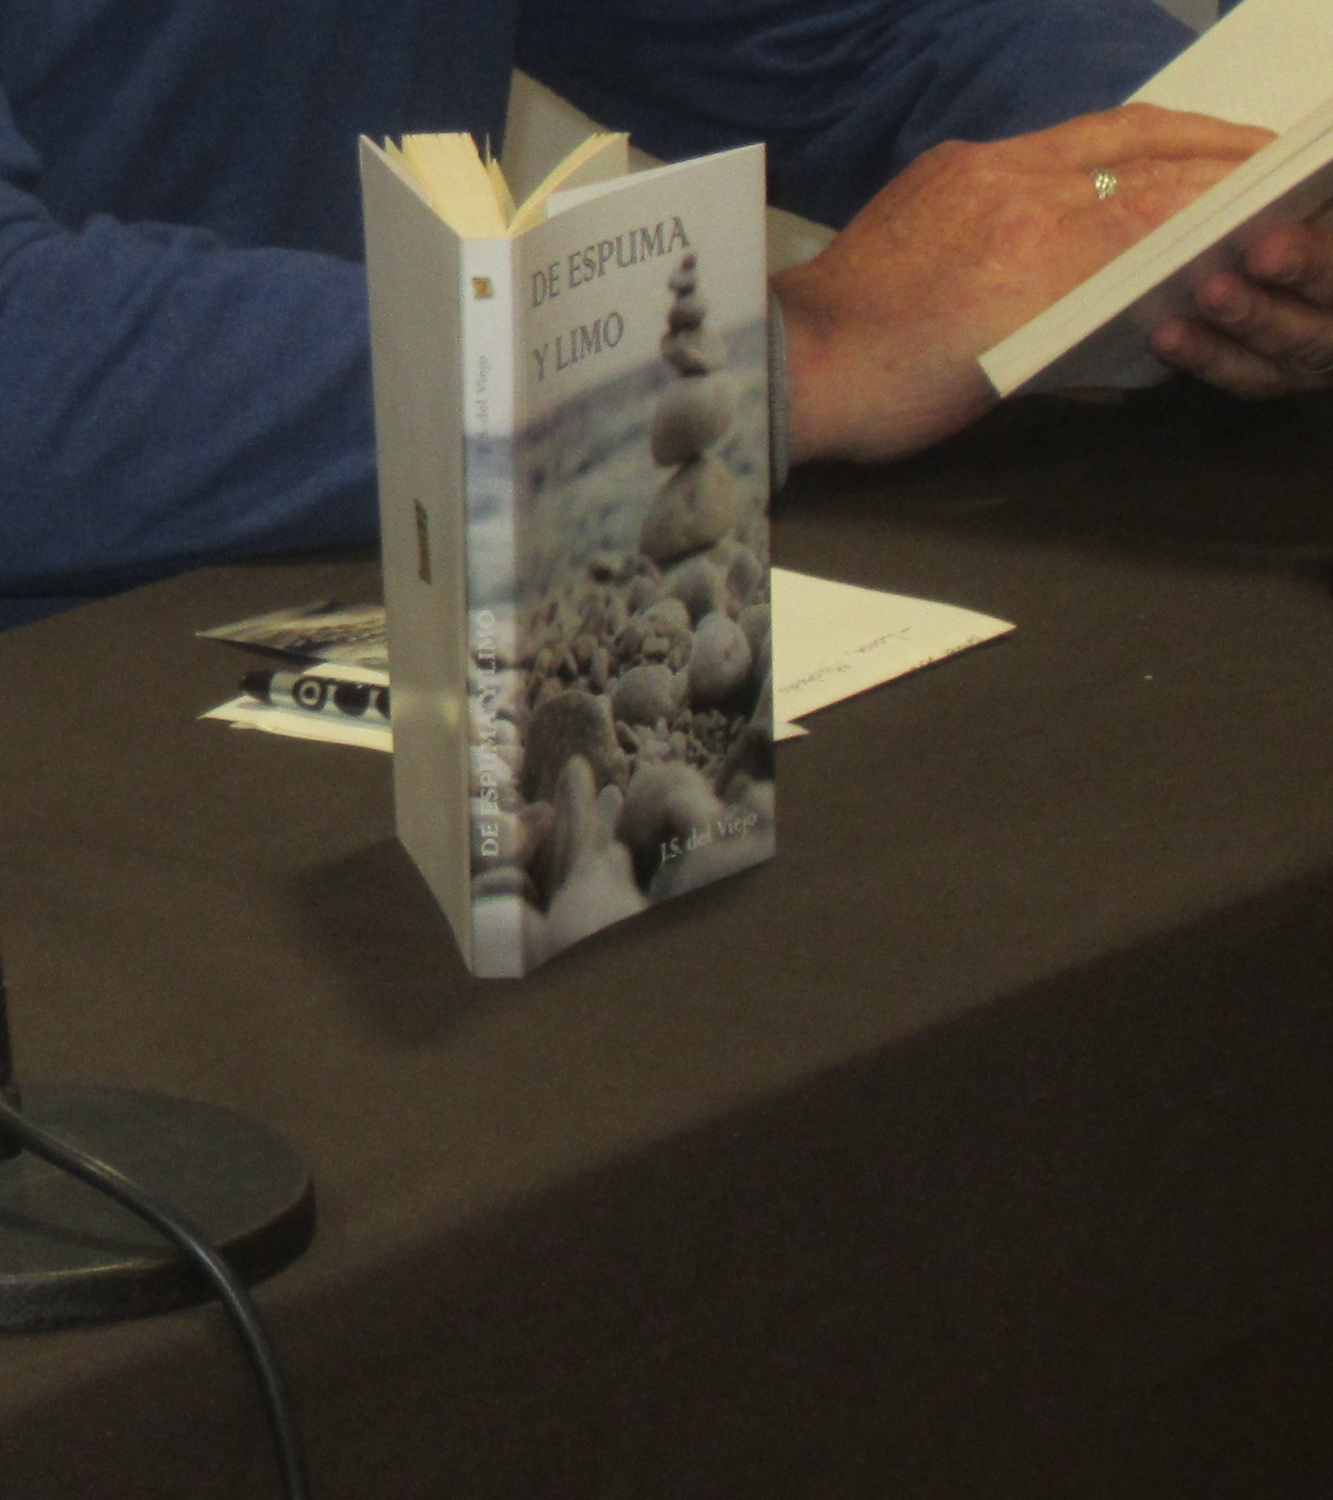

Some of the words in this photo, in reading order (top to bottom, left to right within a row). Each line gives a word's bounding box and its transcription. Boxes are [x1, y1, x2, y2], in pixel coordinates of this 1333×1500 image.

[532, 261, 561, 308] DE
[568, 215, 692, 289] ESPUMA
[533, 342, 549, 382] Y
[555, 310, 625, 371] LIMO
[478, 609, 496, 675] LIMO
[481, 822, 499, 857] DE
